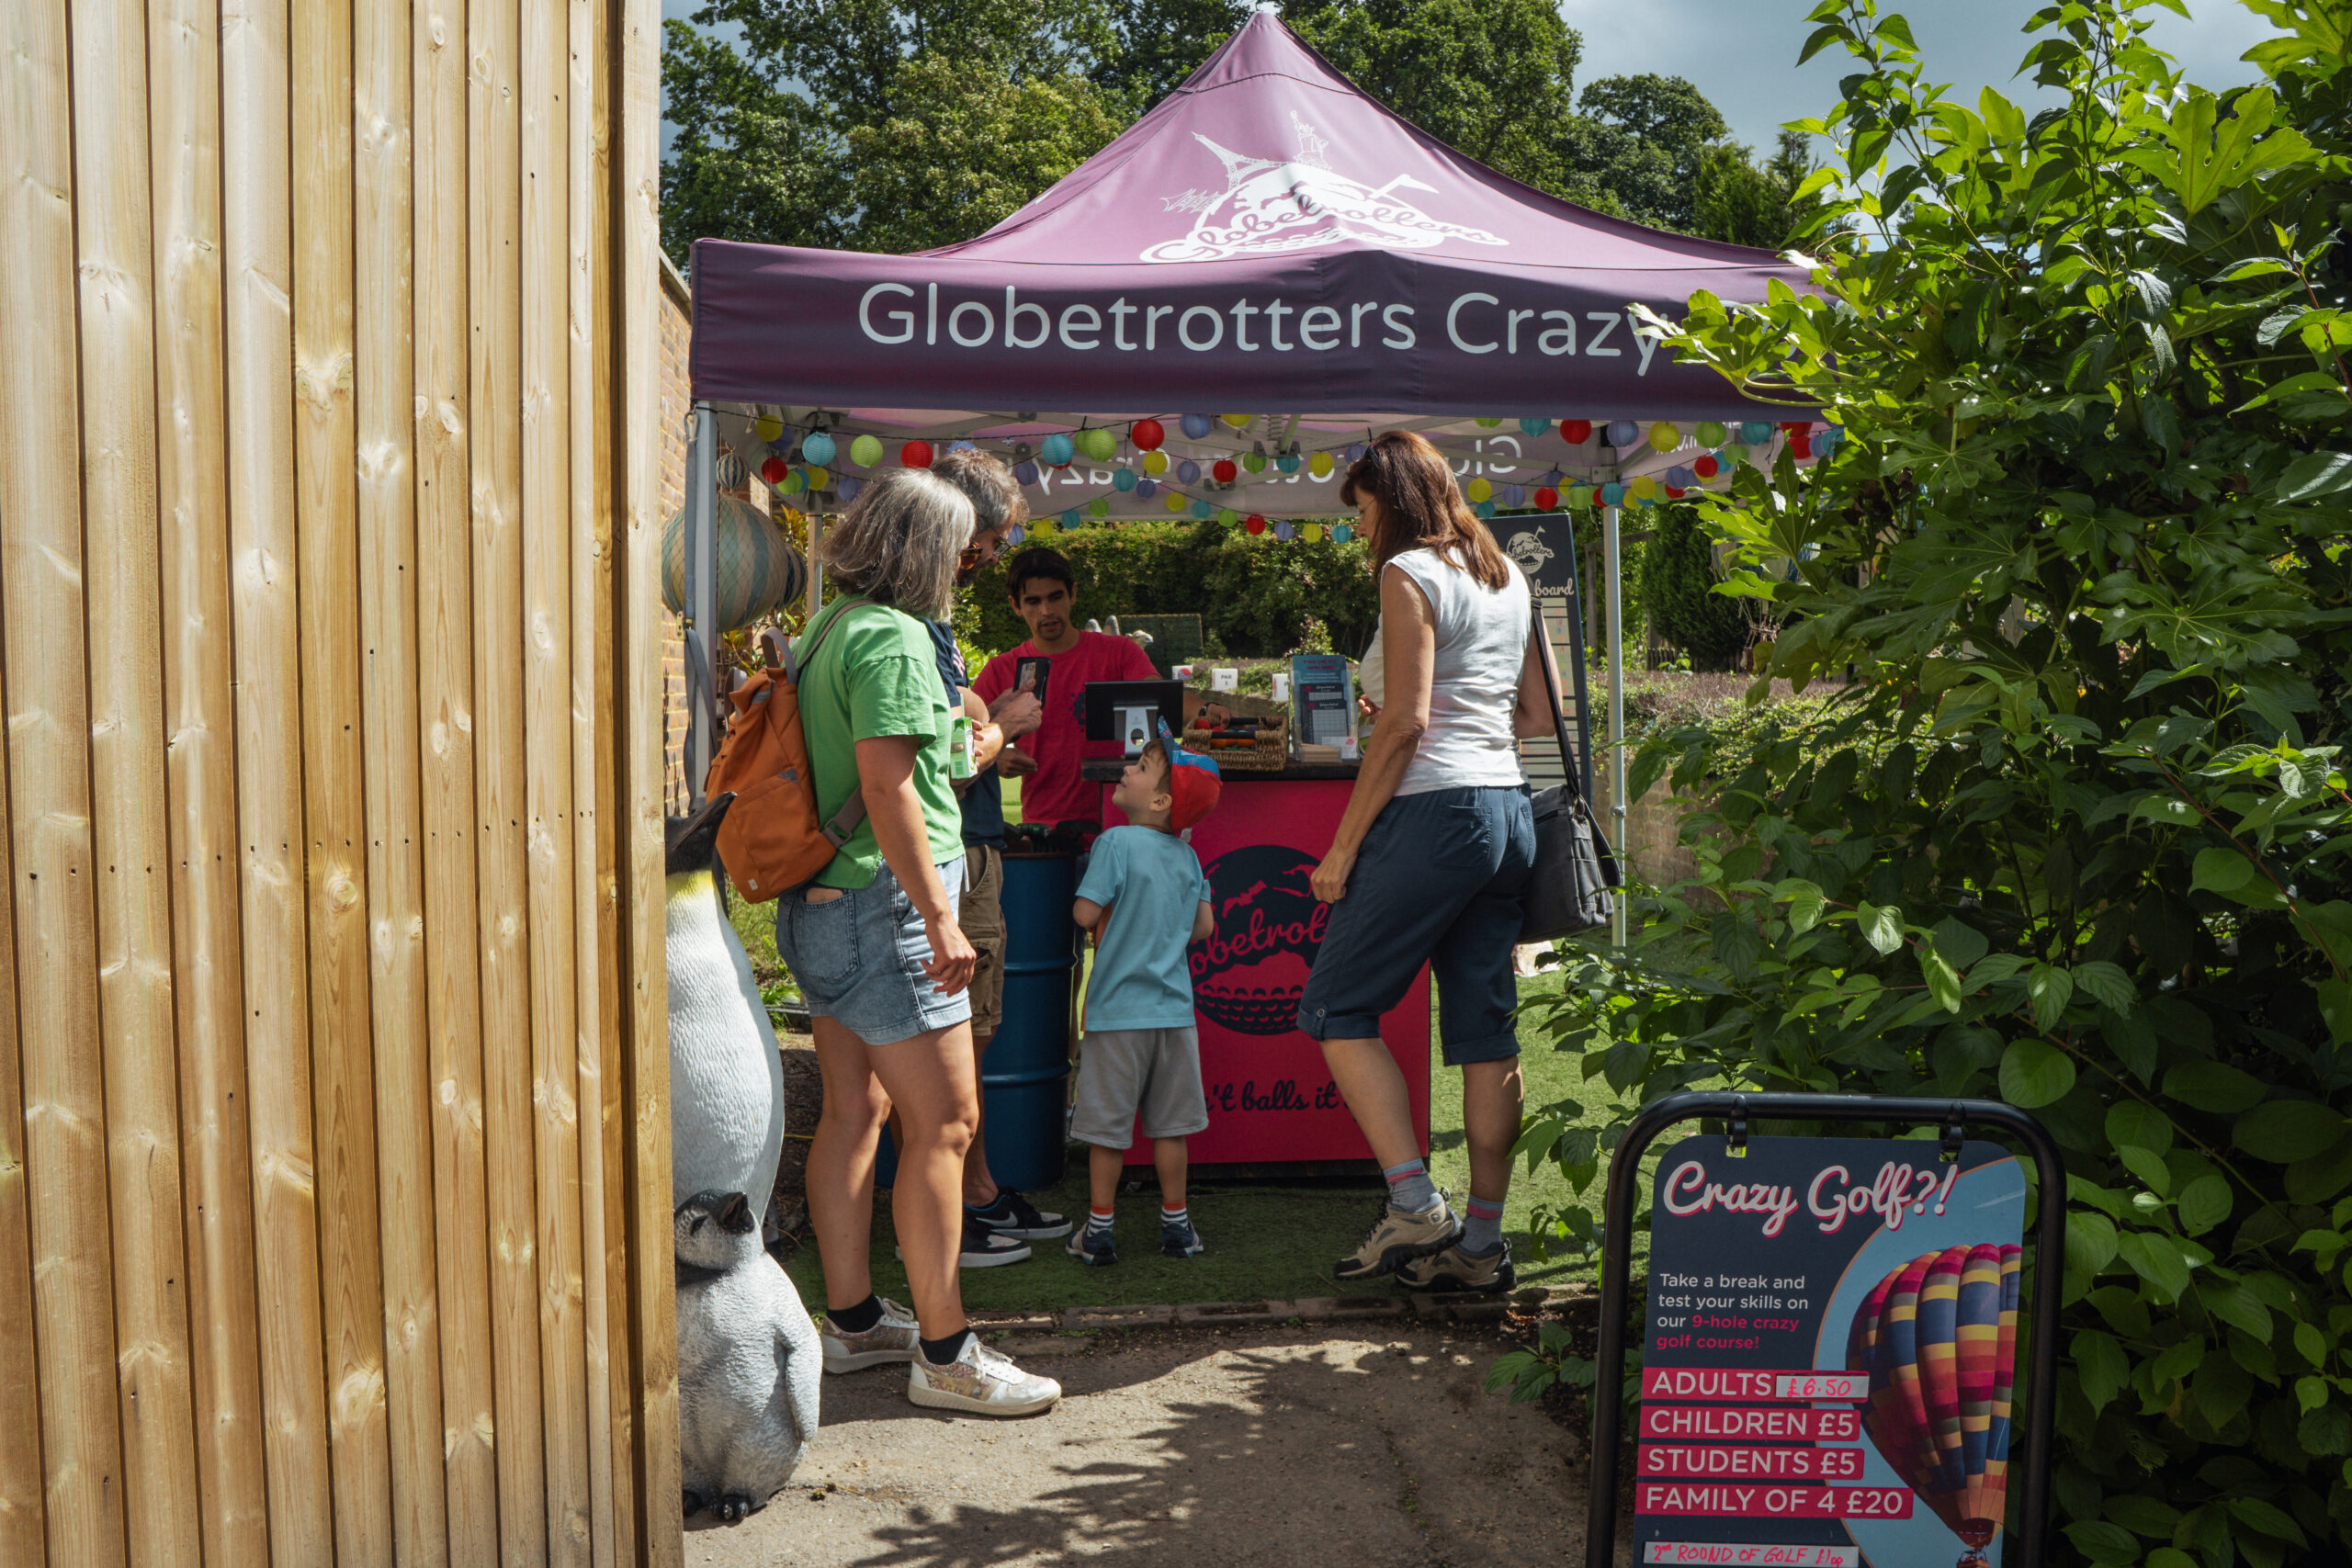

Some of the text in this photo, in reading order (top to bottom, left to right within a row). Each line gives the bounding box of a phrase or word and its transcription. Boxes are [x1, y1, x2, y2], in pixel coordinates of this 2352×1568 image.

[858, 281, 1418, 353] Globetrotters
[1446, 291, 1669, 378] Crazy
[1241, 1079, 1310, 1111] balls
[1315, 1080, 1339, 1110] it
[1663, 1160, 1959, 1237] Crazy Golf?!
[1659, 1272, 1805, 1290] Take a break and
[1658, 1293, 1808, 1311] test your skills on
[1657, 1314, 1799, 1332] our 9-hole crazy
[1656, 1334, 1759, 1350] golf course!
[1652, 1371, 1771, 1396] ADULTS
[1650, 1409, 1854, 1437] CHILDREN £5
[1647, 1448, 1856, 1475] STUDENTS £5
[1646, 1486, 1904, 1515] FAMILY OF 4 £20
[1677, 1544, 1734, 1562] ROUND
[1738, 1548, 1761, 1563] OF
[1763, 1546, 1808, 1564] GOLF
